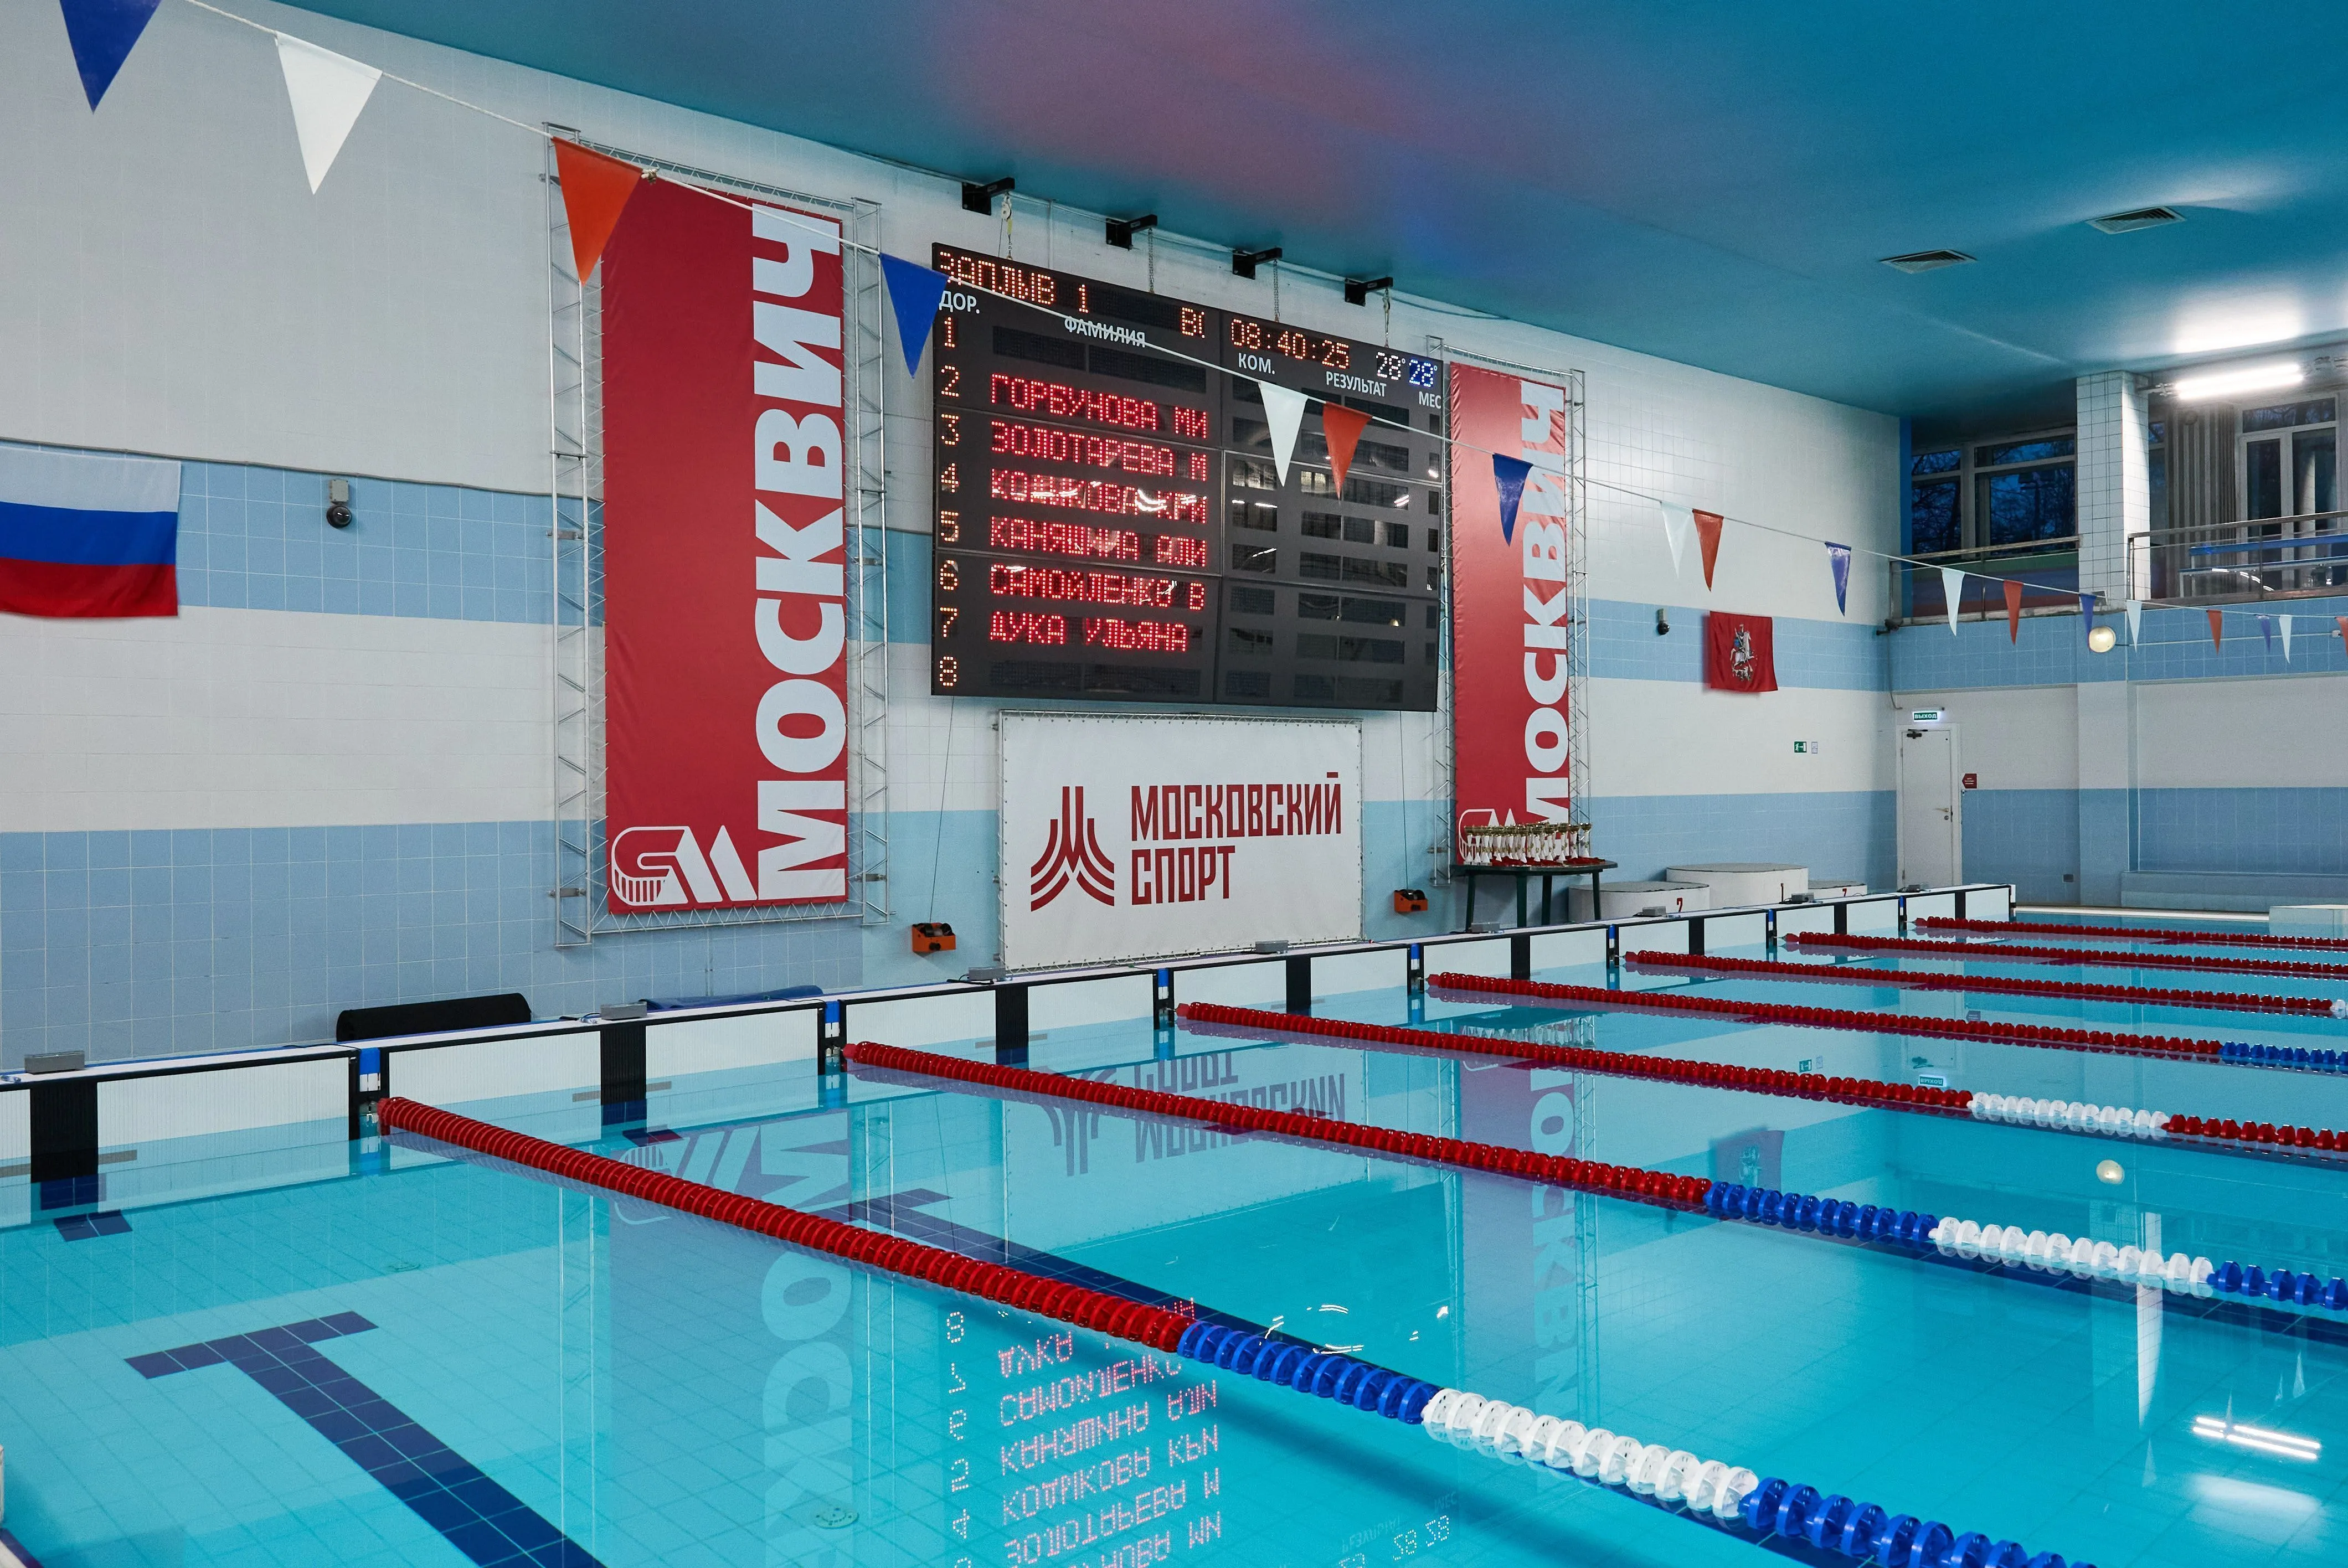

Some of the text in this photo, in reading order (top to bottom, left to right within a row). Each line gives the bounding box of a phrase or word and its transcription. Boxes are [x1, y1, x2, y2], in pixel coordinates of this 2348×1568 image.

[939, 290, 981, 314] ДОР.
[940, 251, 1089, 313] ЗАПЛЫВ 1
[944, 317, 955, 348] 1
[1064, 316, 1145, 348] ФАМИЛИЯ
[1230, 318, 1350, 369] 08:40:25
[1238, 352, 1275, 375] КОМ.
[1326, 371, 1387, 397] РЕЗУЛЬТАТ
[941, 365, 1207, 439] 2 ГОРБУНОВА МИ
[941, 414, 1206, 482] 3 ЗОЛОТАРЕВА М
[941, 463, 959, 493] 4
[940, 510, 959, 542] 5
[751, 203, 846, 901] МОСКВИЧ
[940, 560, 1204, 611] 6 САМОЙЛЕНКО В
[940, 607, 1187, 652] 7 ДУКА УЛЬЯНА
[939, 656, 957, 687] 8
[1131, 772, 1341, 841] МОСКОВСКИЙ
[1131, 845, 1235, 905] СПОРТ
